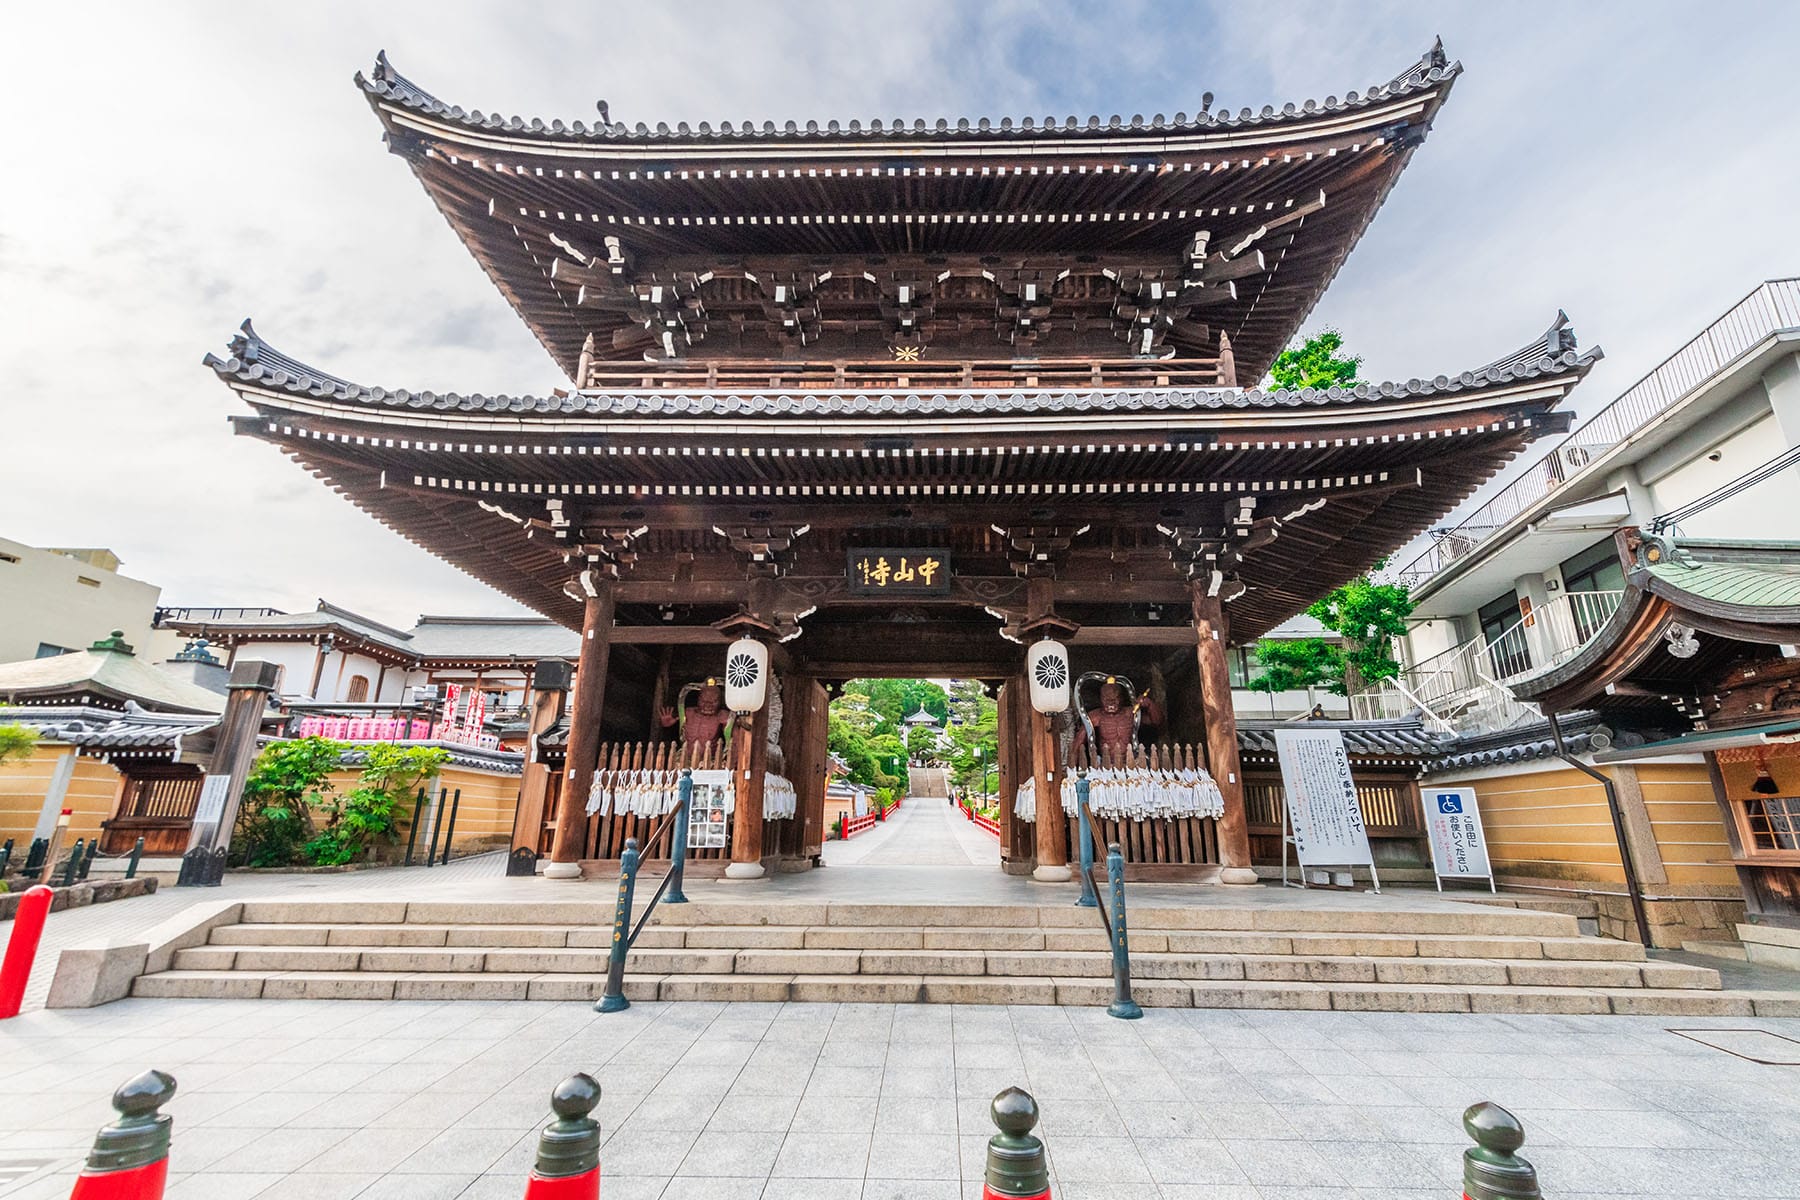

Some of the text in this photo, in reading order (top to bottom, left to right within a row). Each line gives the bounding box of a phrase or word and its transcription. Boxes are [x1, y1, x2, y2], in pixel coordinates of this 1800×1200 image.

[870, 557, 939, 586] 中山寺
[1449, 815, 1469, 873] お使いください
